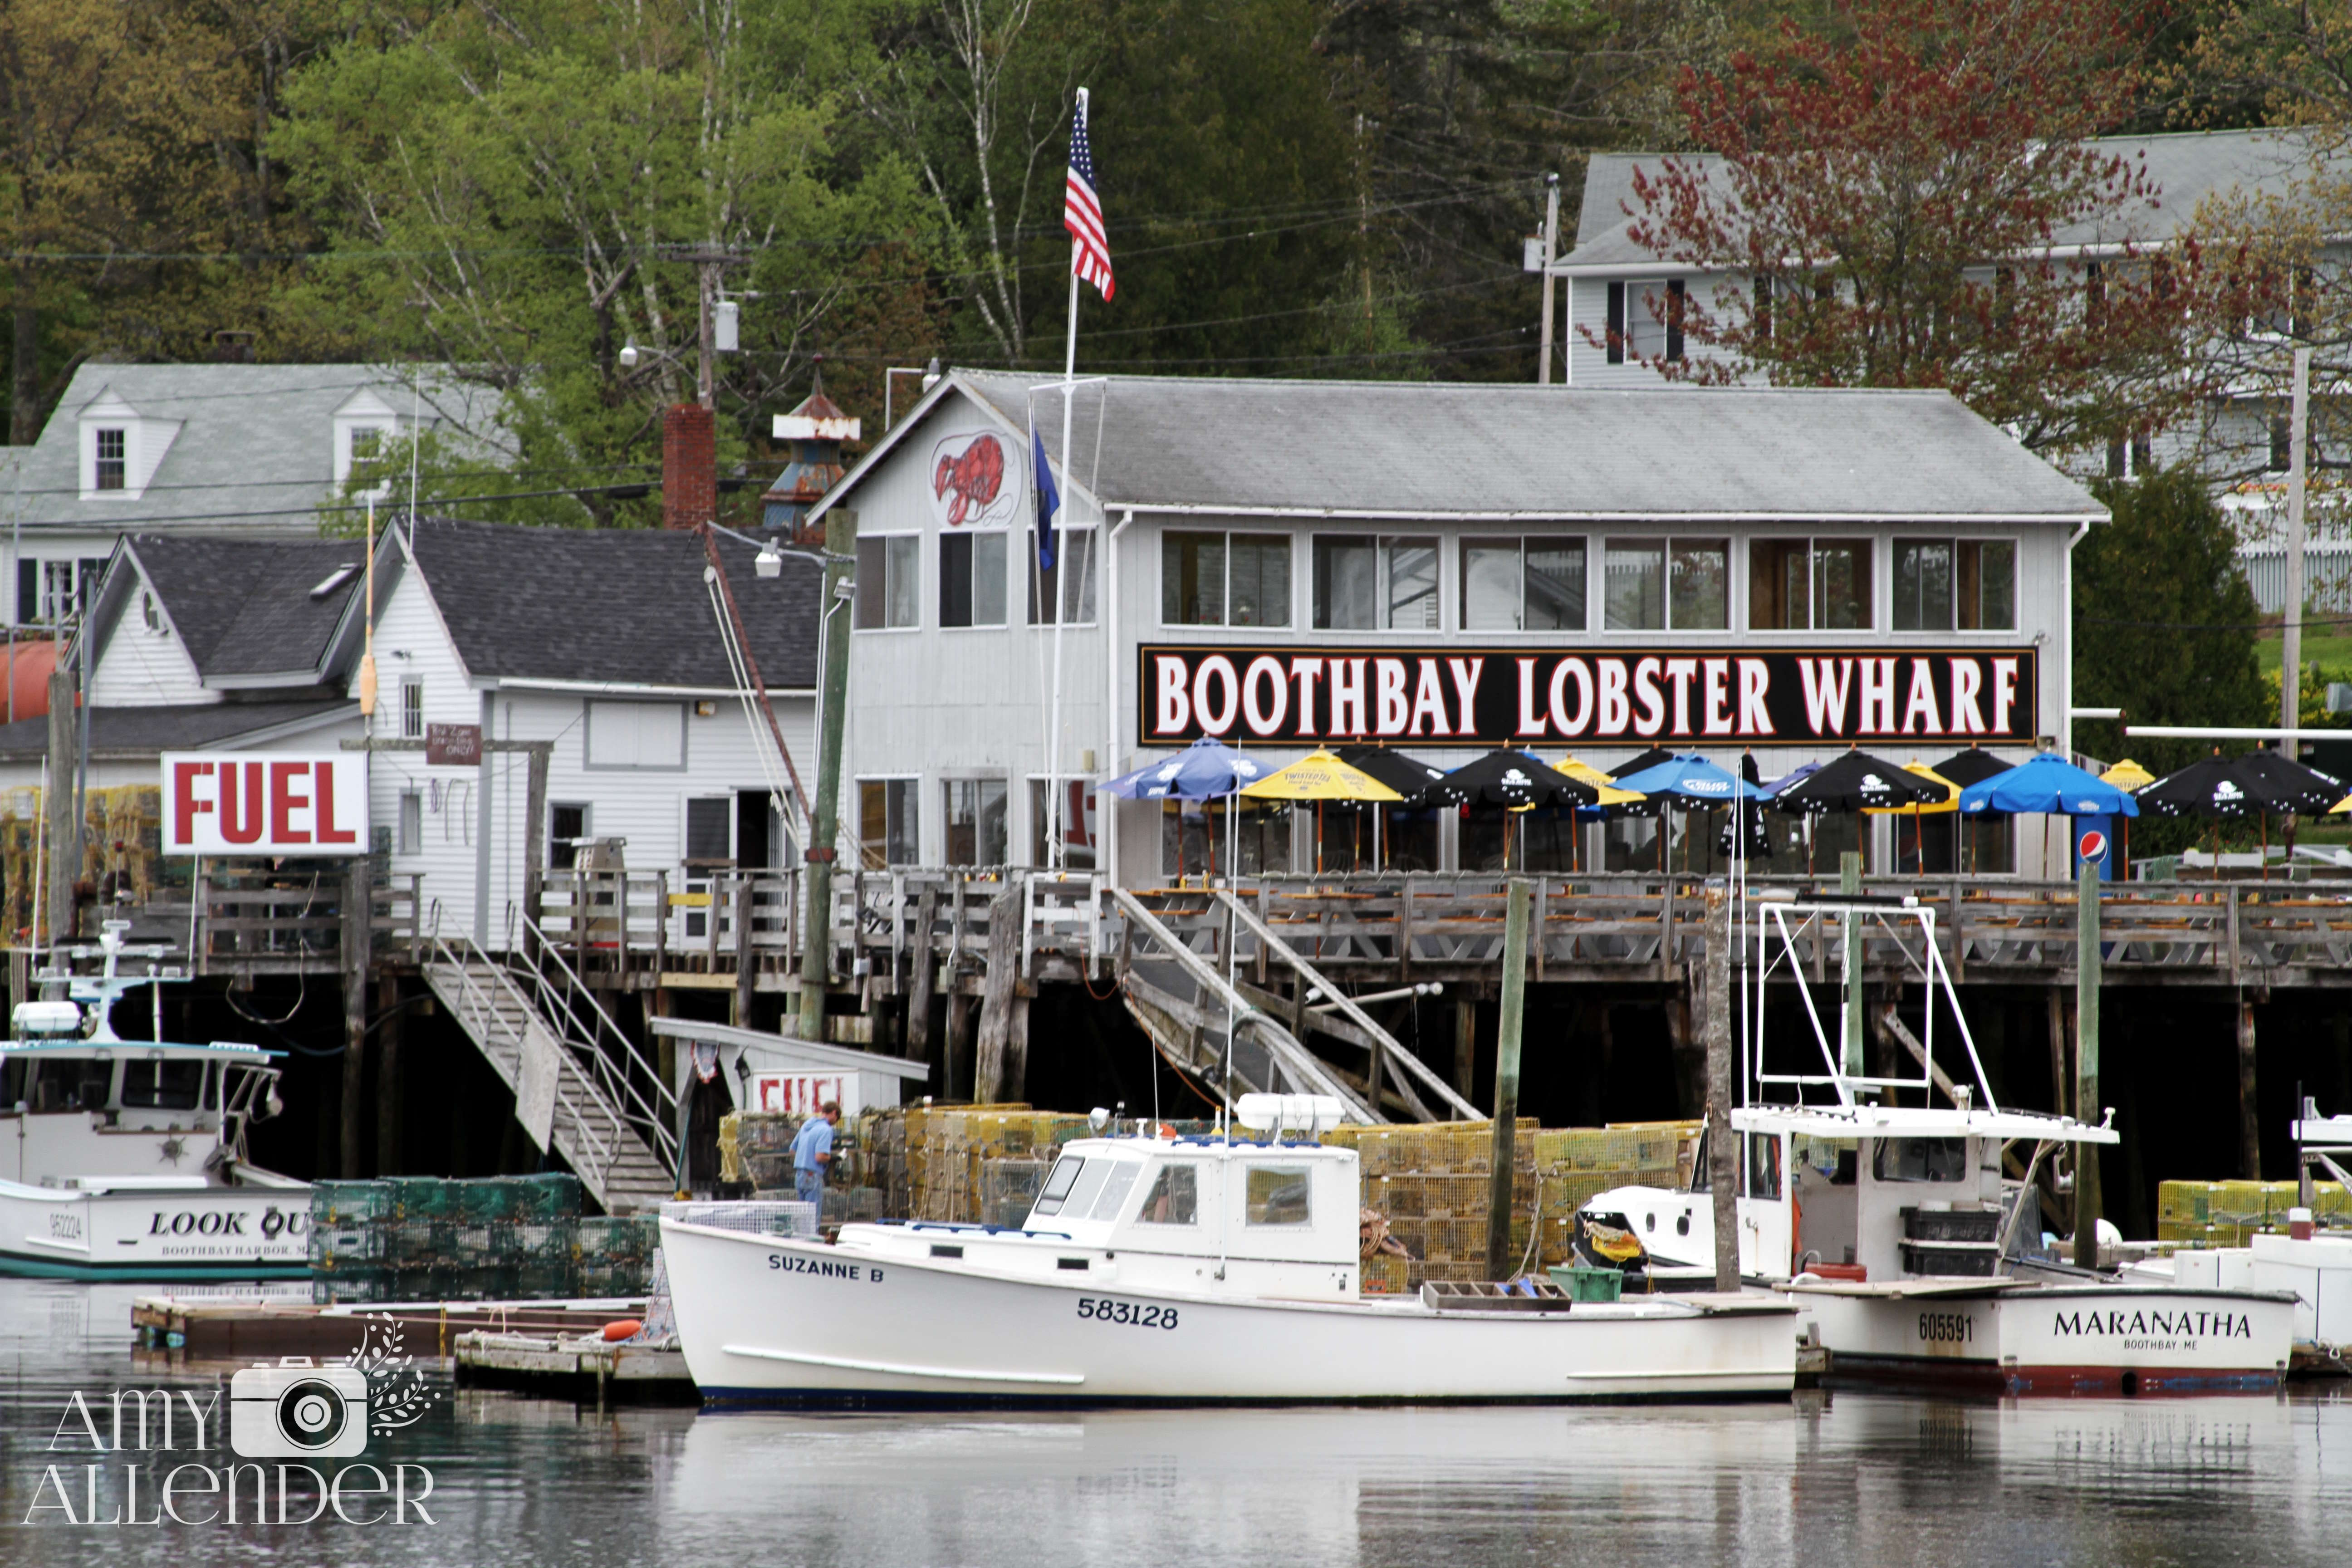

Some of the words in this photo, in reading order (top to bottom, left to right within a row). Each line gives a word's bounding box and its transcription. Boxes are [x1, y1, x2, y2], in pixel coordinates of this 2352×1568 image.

[1152, 654, 1485, 736] BOOTHBAY
[1514, 655, 1777, 737] LOBSTER
[1795, 655, 2018, 737] WHARF
[174, 762, 356, 844] FUEL
[50, 1213, 81, 1240] 952224
[147, 1212, 249, 1237] LOOK
[162, 1245, 231, 1256] BOOTHBAY
[769, 1254, 860, 1280] SUZANNE
[870, 1269, 884, 1283] B
[1077, 1297, 1178, 1330] 583128
[2054, 1311, 2251, 1339] MARANATHA
[1919, 1313, 1972, 1343] 605591
[2124, 1339, 2177, 1351] BOOTHBAY
[2184, 1339, 2198, 1351] ME
